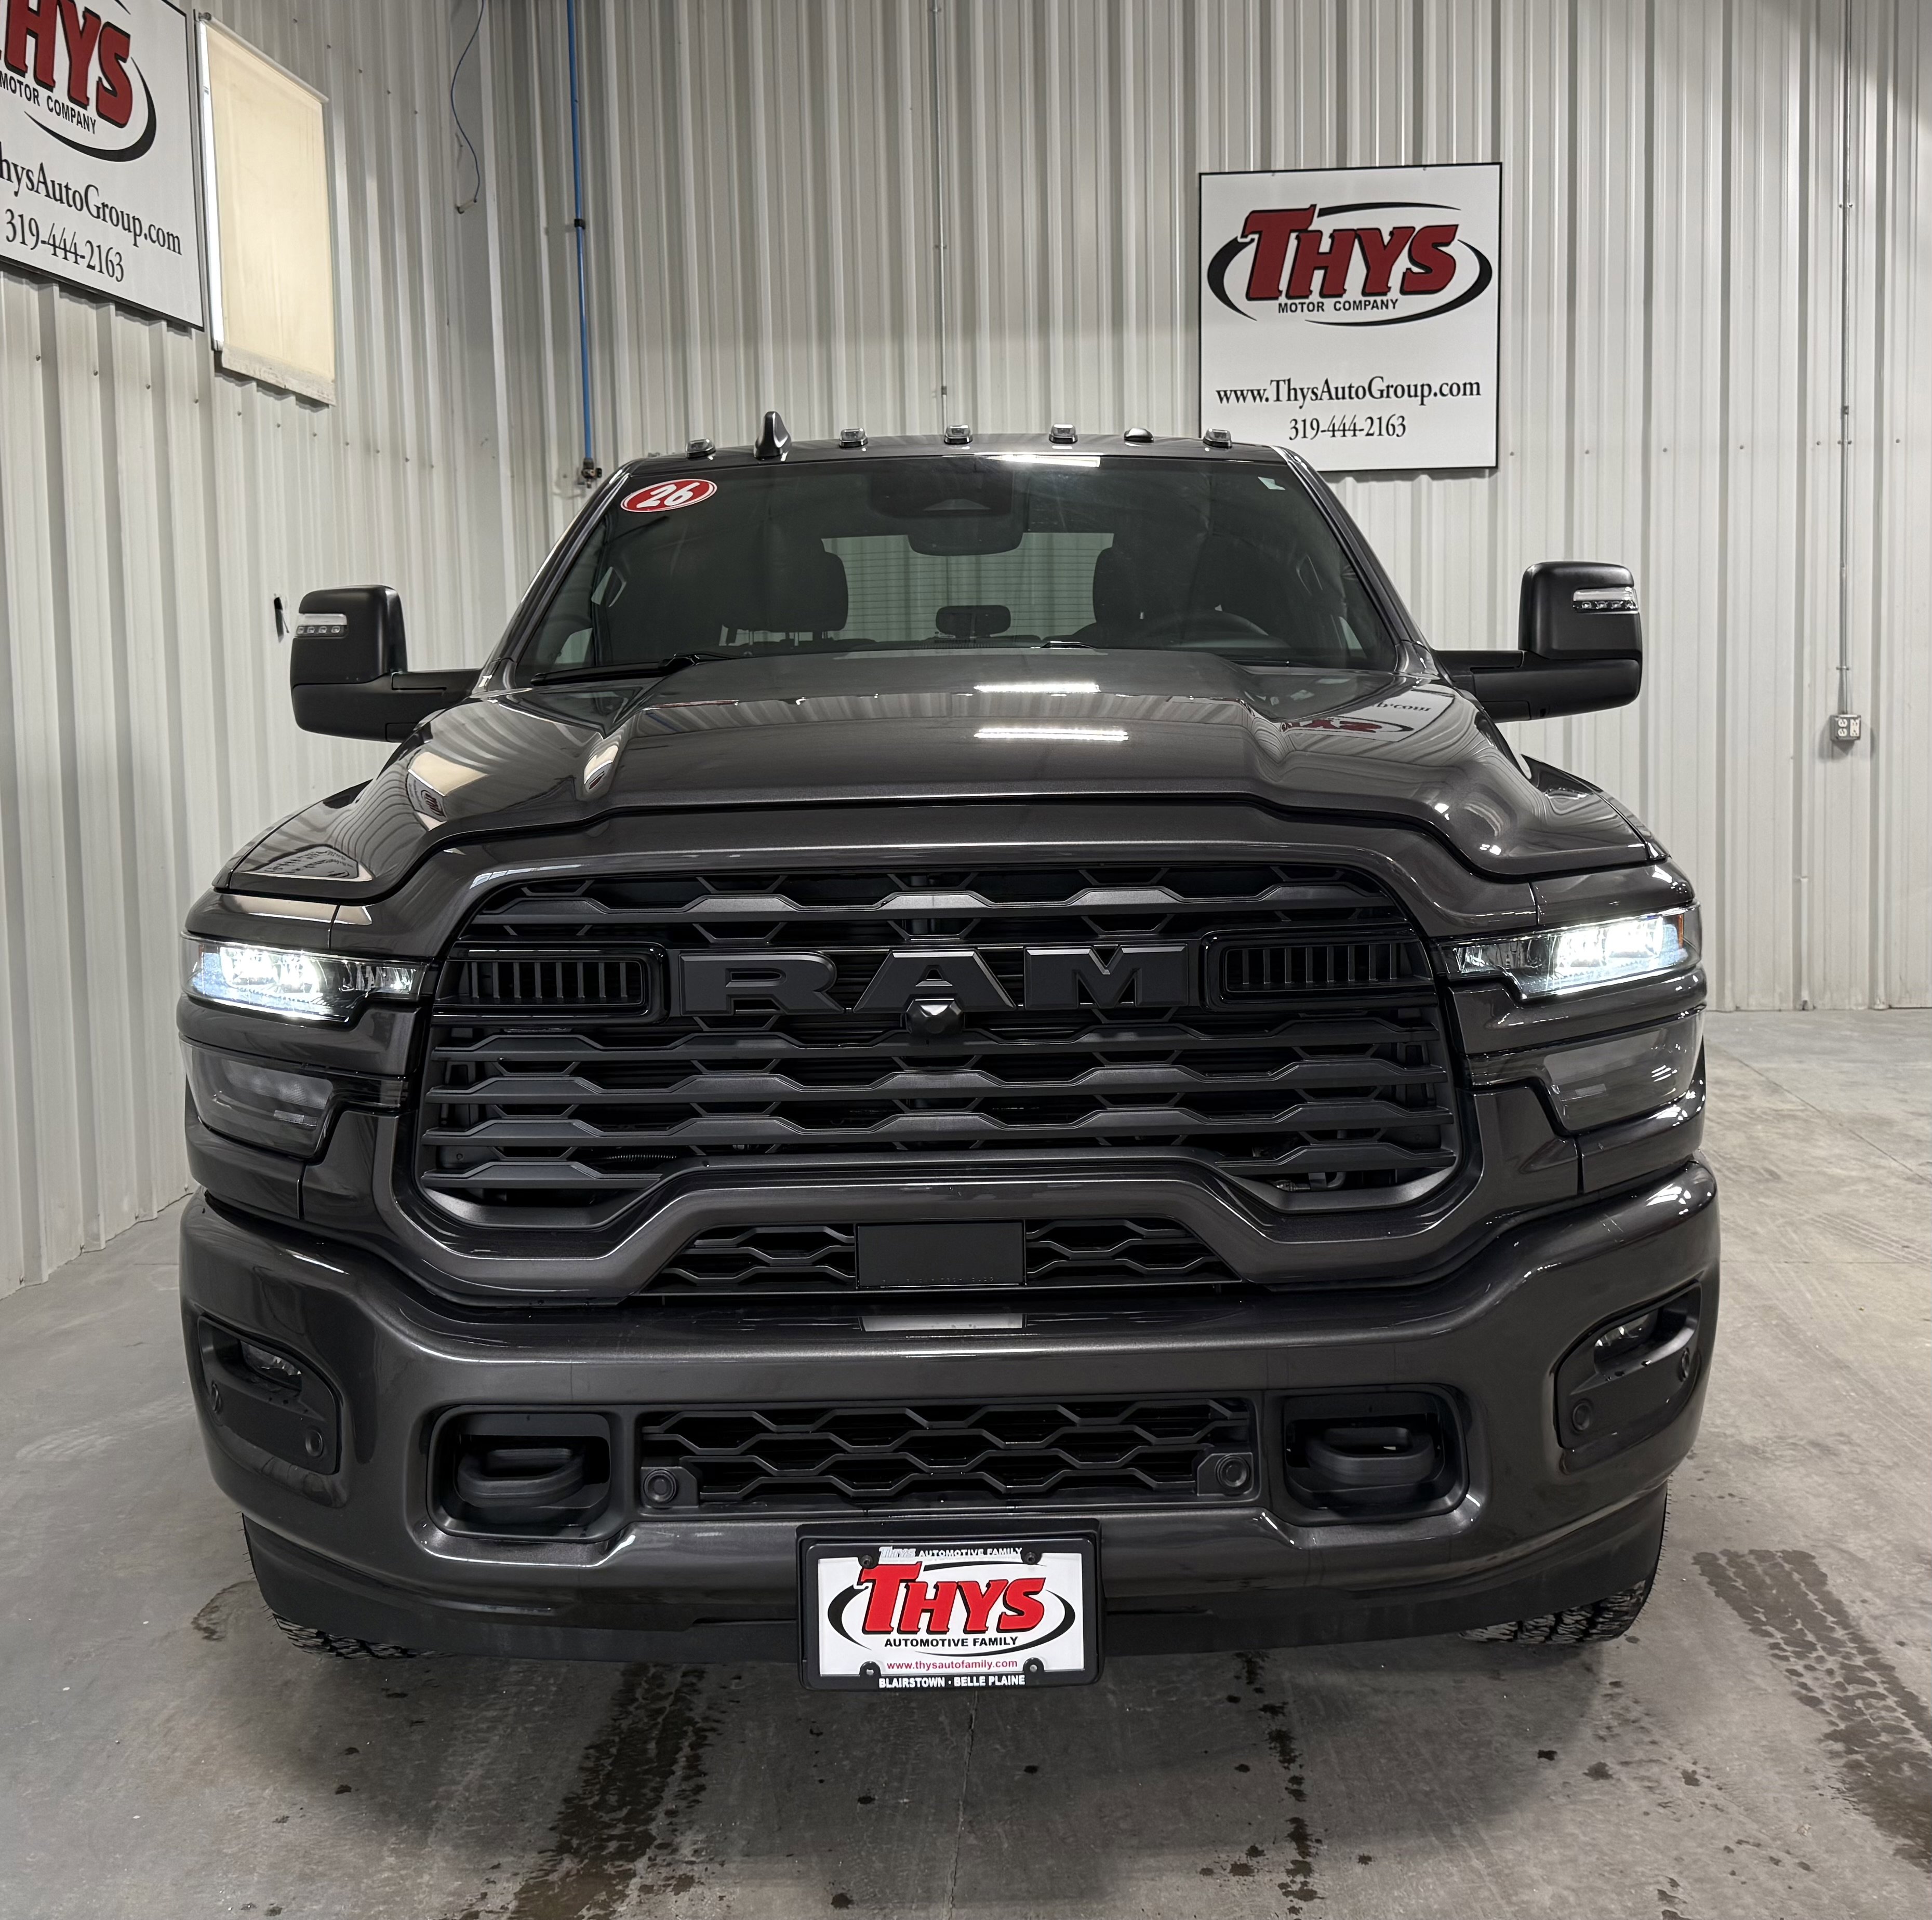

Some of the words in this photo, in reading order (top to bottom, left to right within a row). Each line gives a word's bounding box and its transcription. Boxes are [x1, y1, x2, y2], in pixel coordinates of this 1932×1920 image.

[0, 0, 134, 129] HYS
[0, 71, 40, 106] MOTOR
[46, 95, 97, 134] COMPANY
[5, 208, 125, 282] 319-444-2163
[1240, 204, 1459, 301] THYS
[1278, 301, 1325, 313] MOTOR
[1334, 299, 1398, 311] COMPANY
[1216, 376, 1481, 409] www.ThysAutoGroup.com
[1289, 414, 1406, 440] 319-444-2163
[636, 482, 700, 508] 26
[679, 943, 1190, 1015] RAM
[918, 1549, 984, 1557] AUTOMOTIVE
[988, 1548, 1022, 1556] FAMILY
[858, 1562, 1046, 1635] THYS
[884, 1638, 968, 1647] AUTOMOTIVE
[973, 1636, 1018, 1646] FAMILY
[887, 1660, 1018, 1671] www.thysautofamily.com
[879, 1677, 945, 1688] BLAIRSTOWN
[954, 1676, 986, 1687] BELLE
[989, 1675, 1025, 1686] PLAINE
